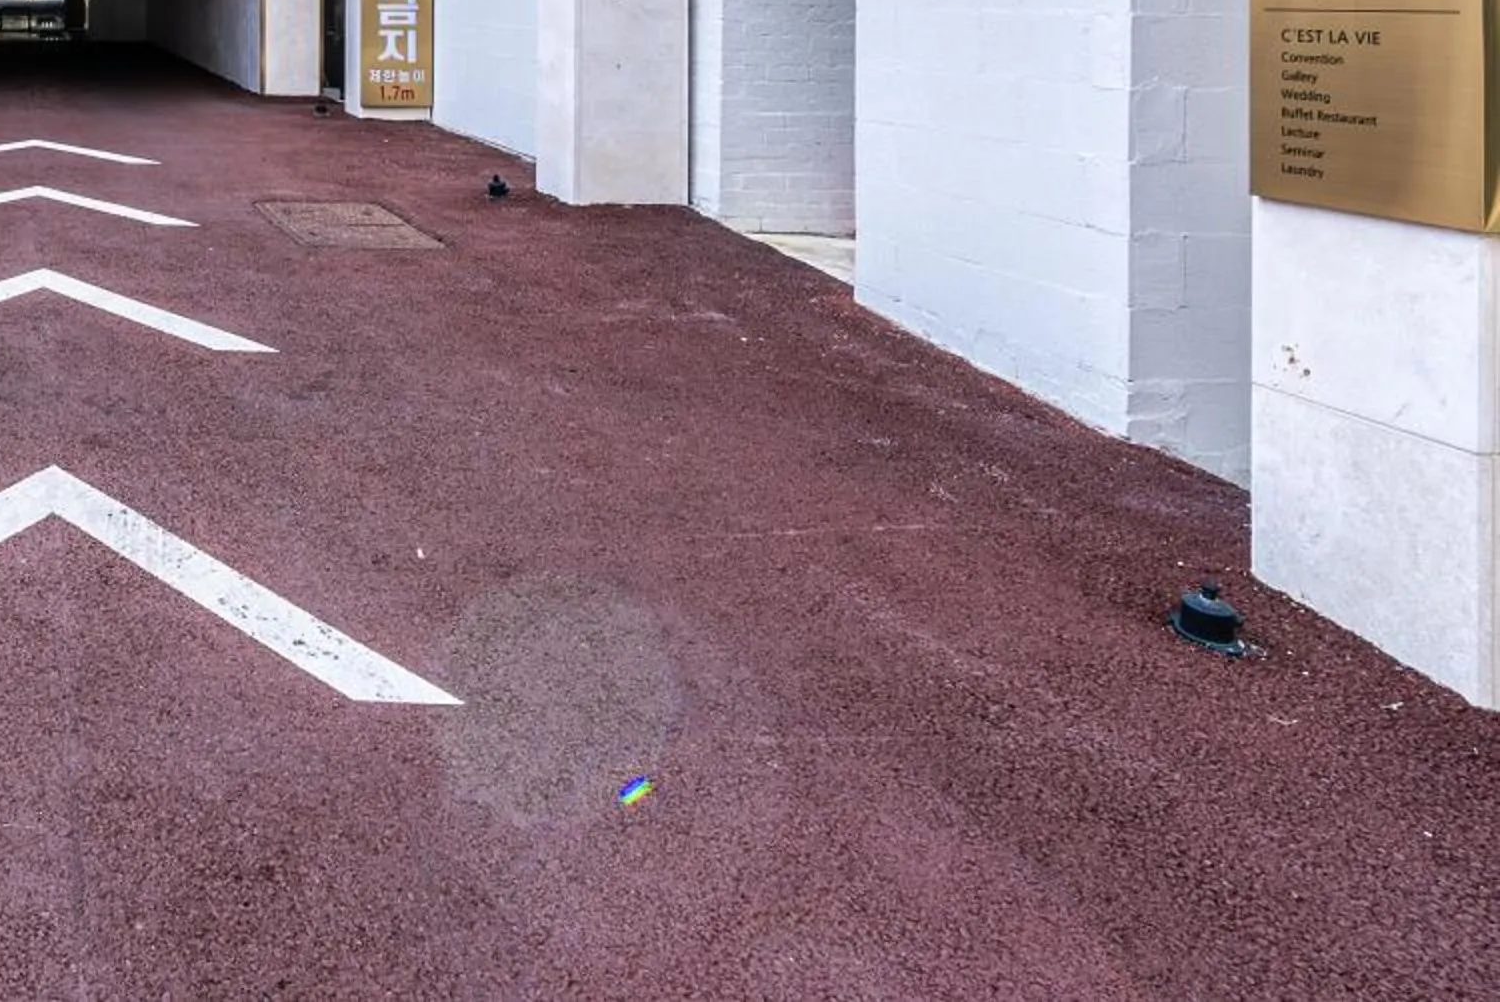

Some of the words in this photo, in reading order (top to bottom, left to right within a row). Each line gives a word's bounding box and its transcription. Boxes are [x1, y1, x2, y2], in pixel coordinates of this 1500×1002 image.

[1281, 28, 1324, 44] C'EST
[1329, 29, 1349, 44] LA
[1355, 31, 1381, 46] VIE
[1281, 51, 1345, 66] Convention
[1281, 69, 1318, 85] Gallery
[380, 85, 415, 101] 1.7m
[1281, 88, 1331, 104] Wedding
[1281, 106, 1313, 121] Buffet
[1317, 109, 1377, 127] Restaurant
[1281, 125, 1320, 139] Lecture
[1281, 143, 1325, 159] Seminar
[1281, 162, 1324, 178] Laundry
